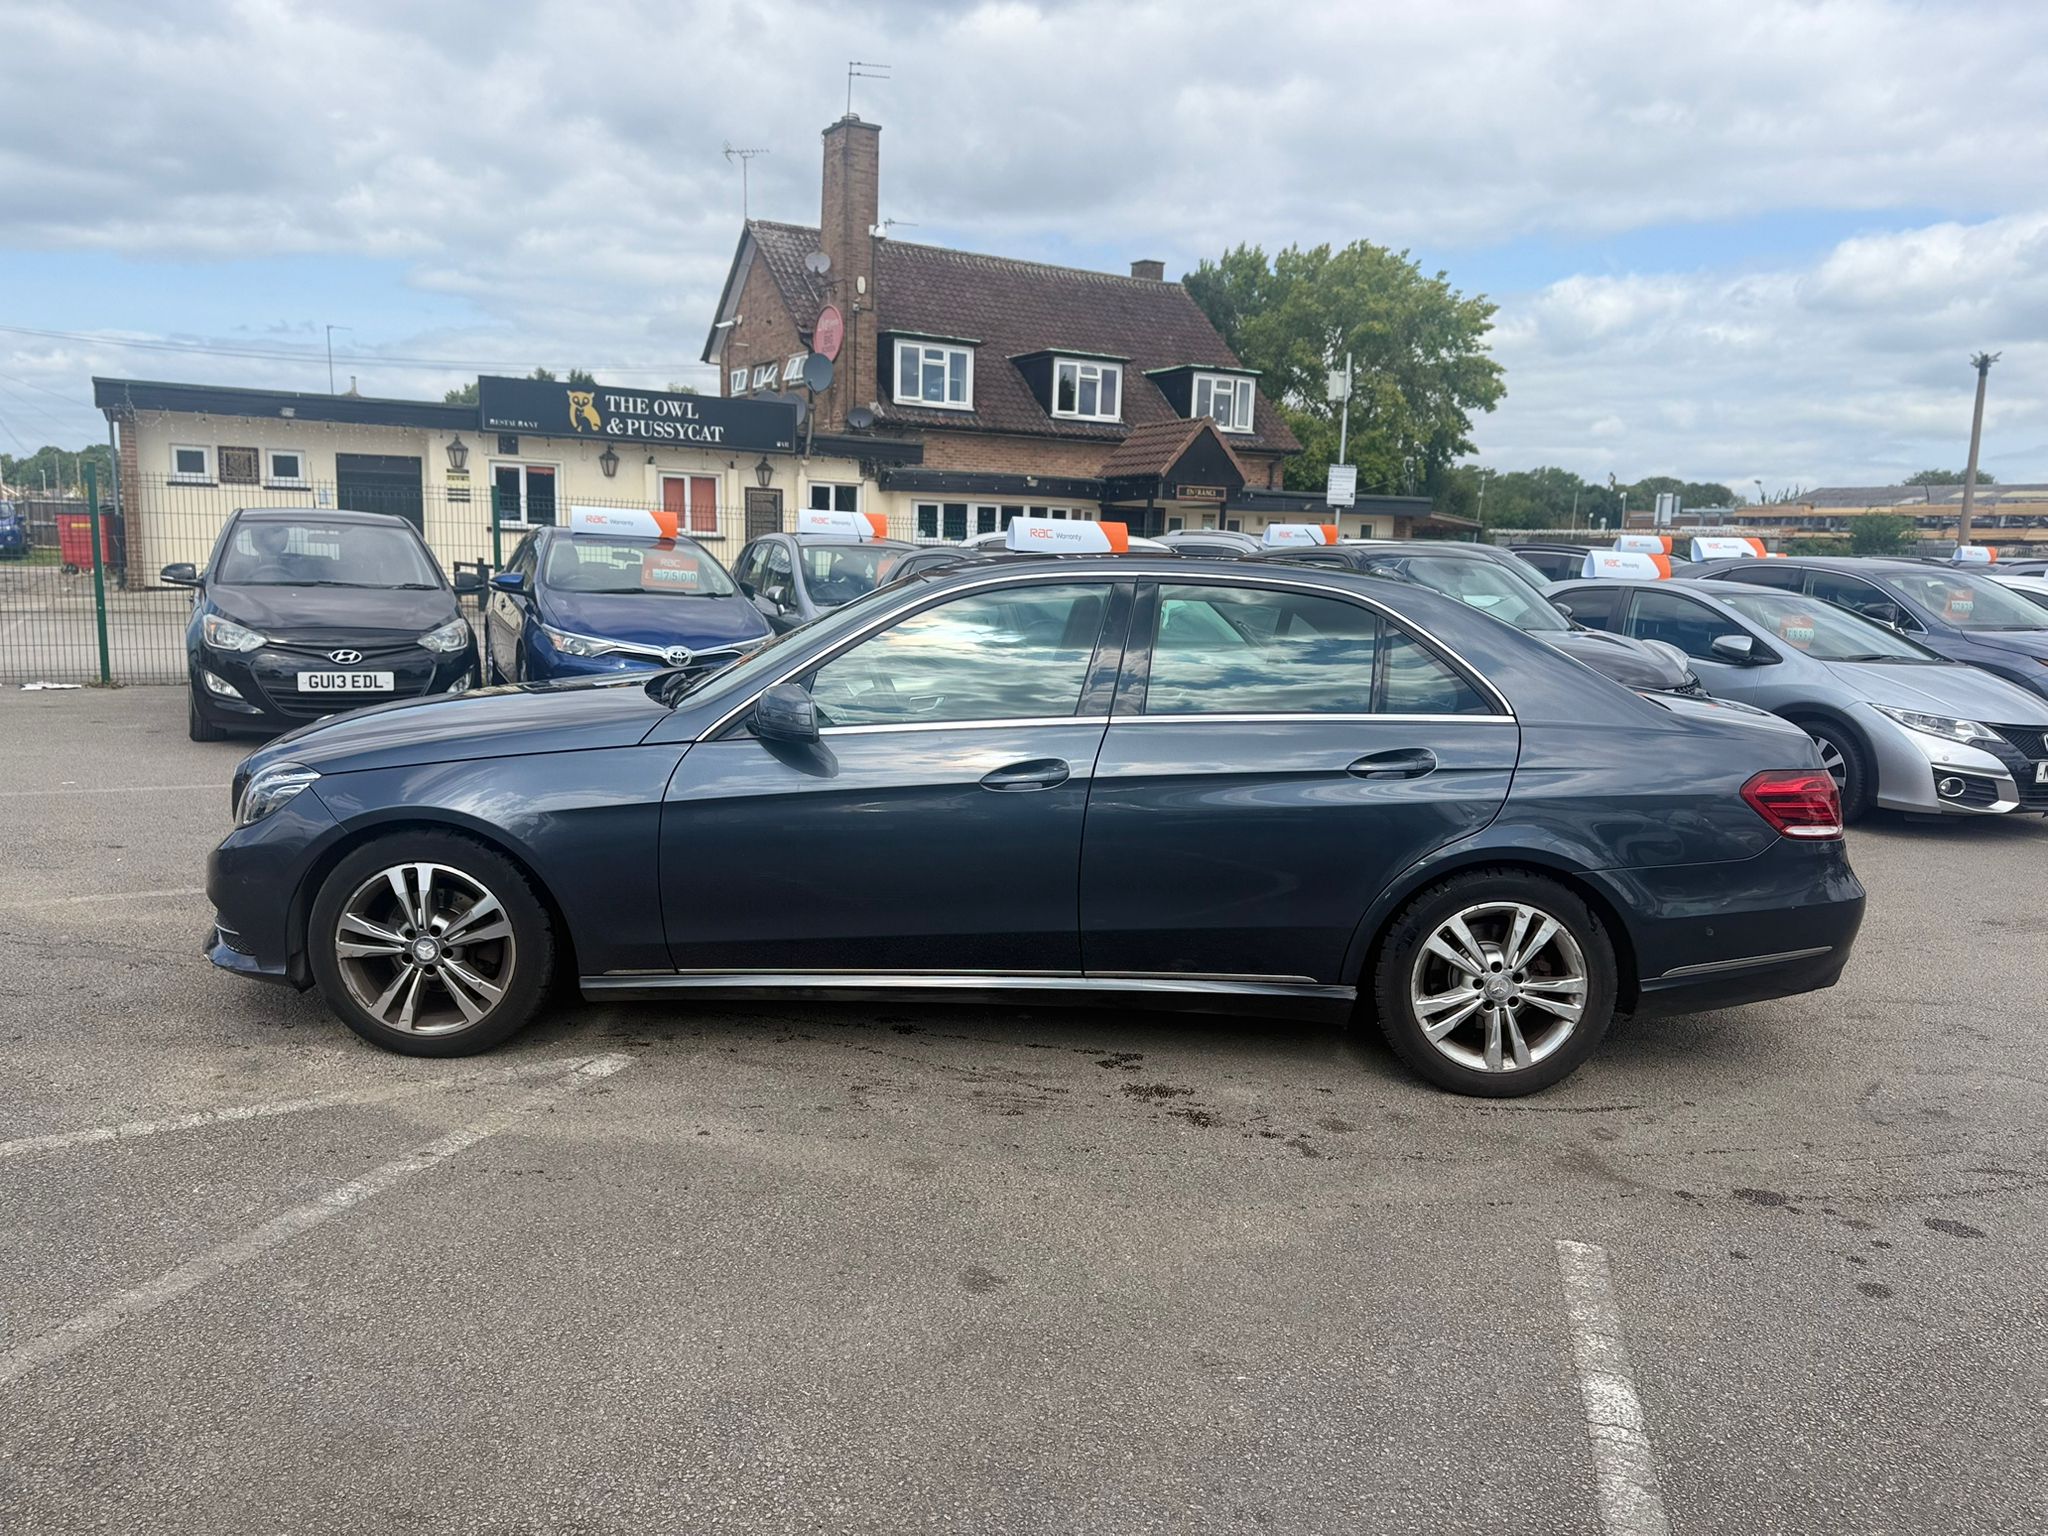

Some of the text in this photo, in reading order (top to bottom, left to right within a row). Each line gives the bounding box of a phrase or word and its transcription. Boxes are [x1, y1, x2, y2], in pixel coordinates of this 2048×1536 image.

[605, 394, 699, 419] THE OWL
[625, 419, 724, 442] PUSSYCAT
[1055, 533, 1082, 542] Warranty
[308, 674, 384, 689] GU13 EDL
